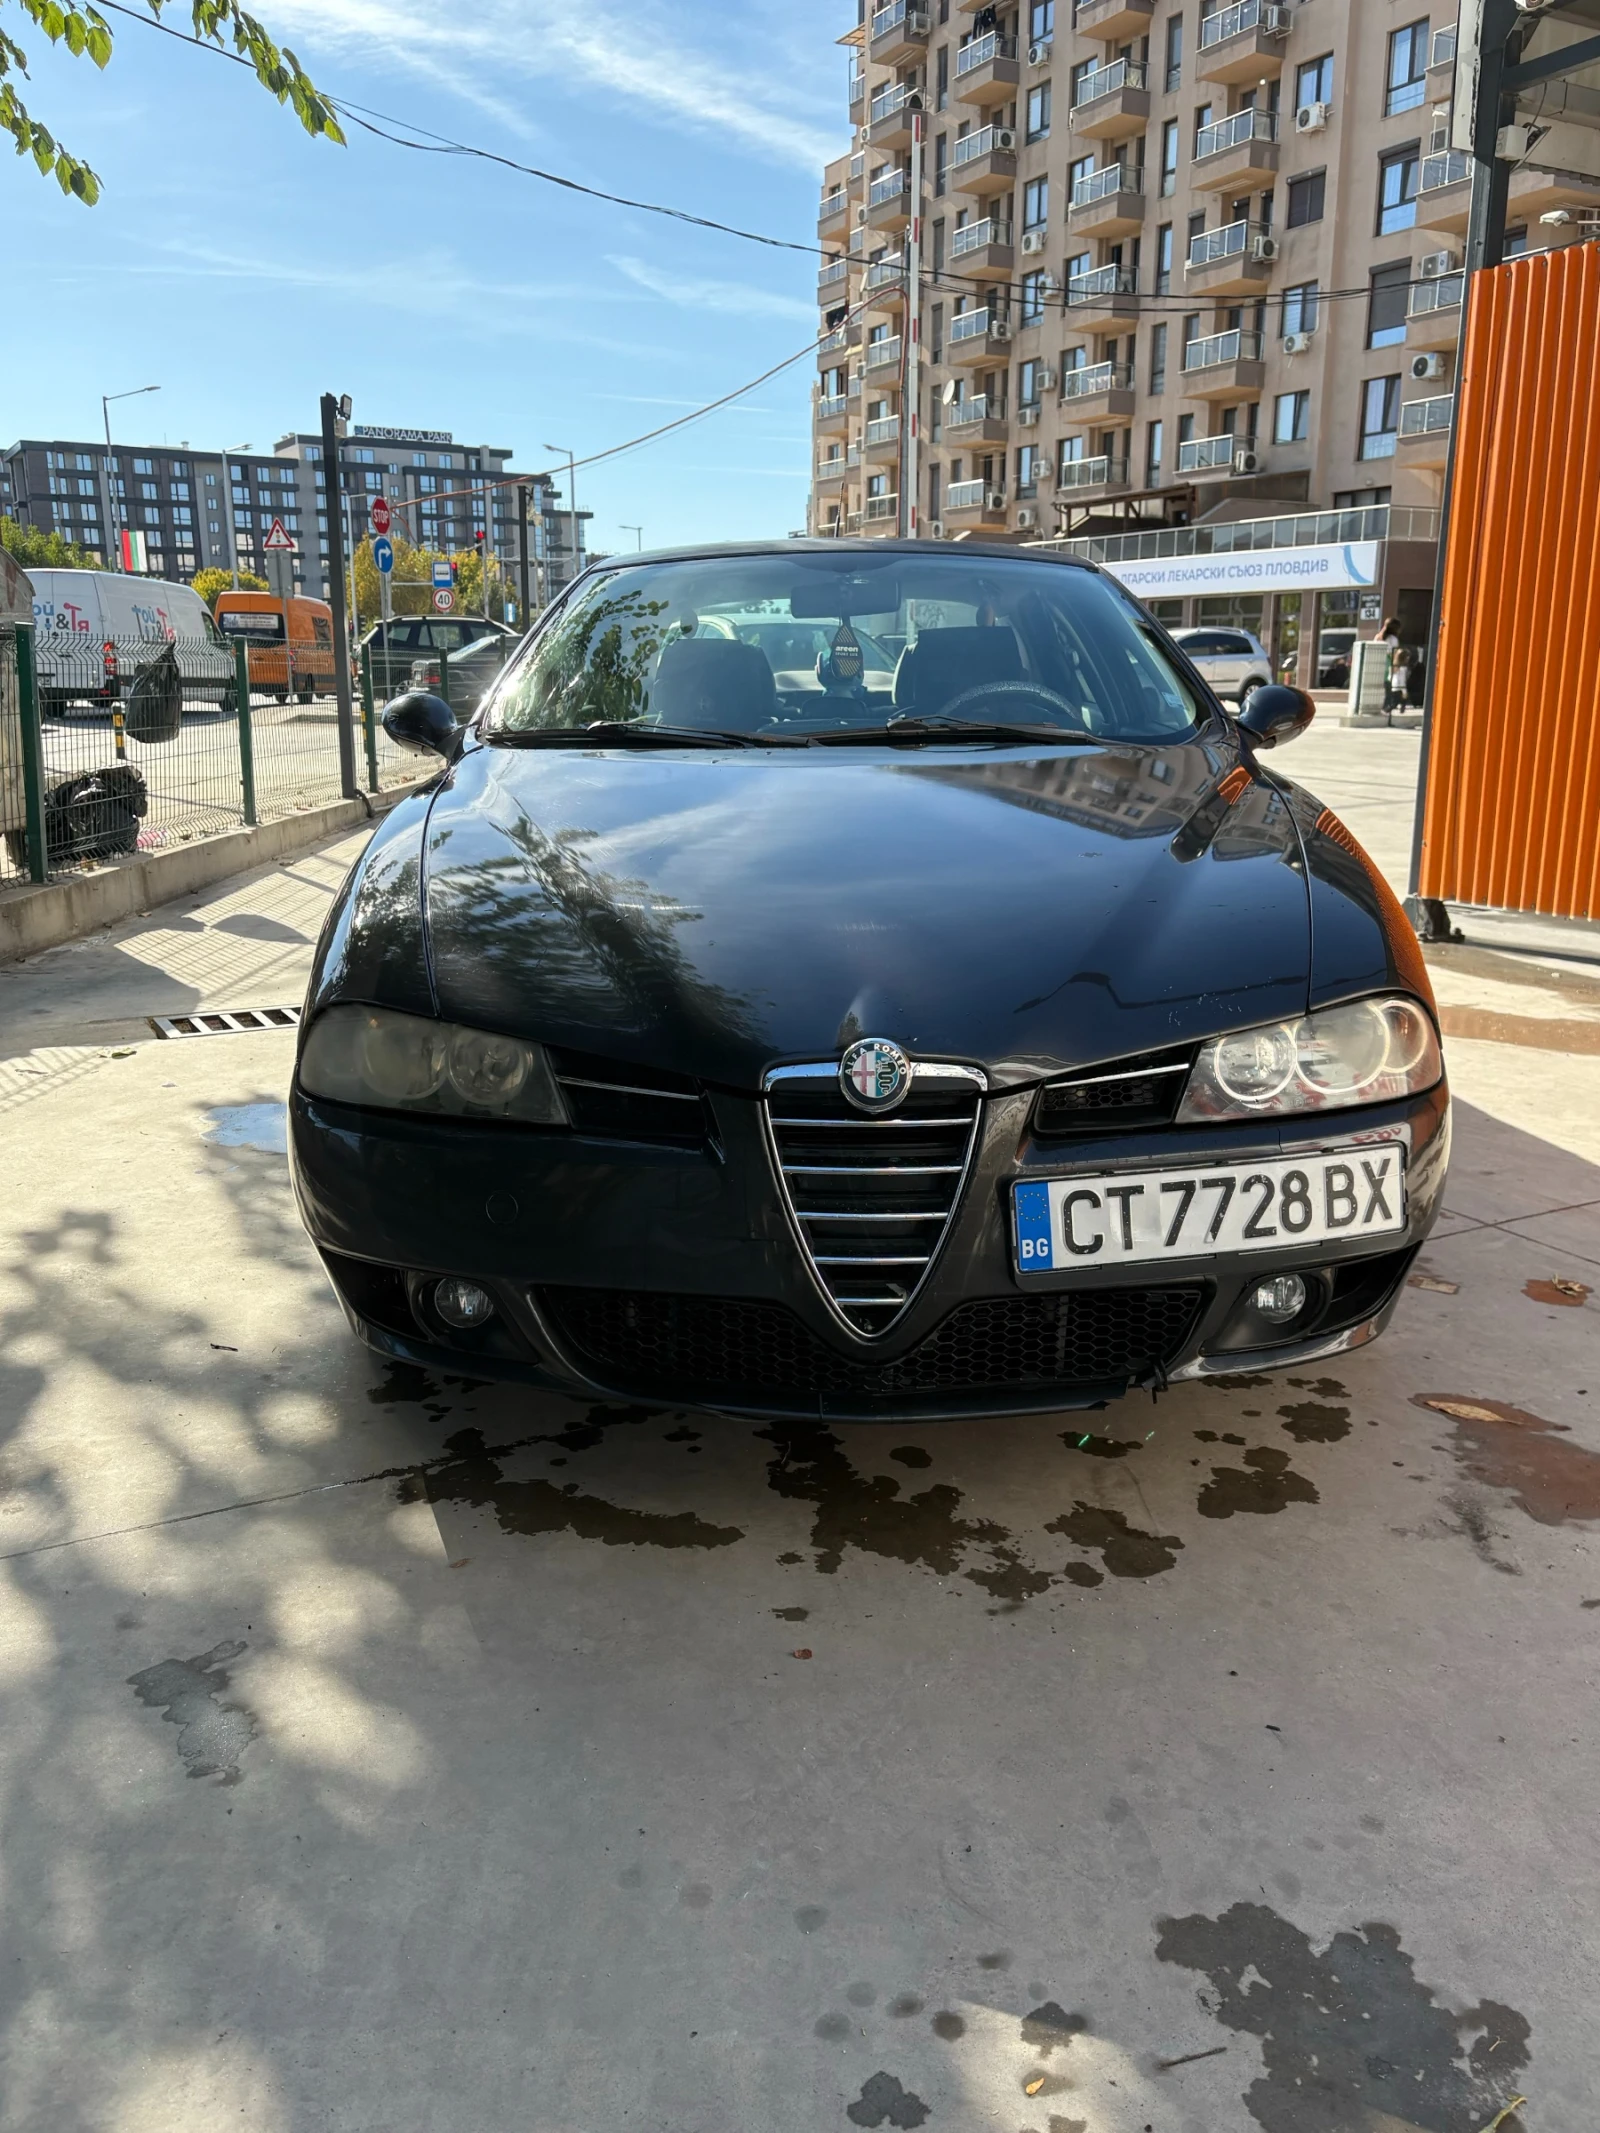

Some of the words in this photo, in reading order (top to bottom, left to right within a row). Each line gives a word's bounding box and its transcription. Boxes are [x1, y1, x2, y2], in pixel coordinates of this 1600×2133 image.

[362, 426, 425, 441] PANORAMA
[427, 432, 453, 443] PARK
[373, 509, 389, 524] STOP
[1119, 571, 1166, 585] ЛГАРСКИ
[1167, 567, 1225, 583] ЛЕКАРСКИ
[1227, 563, 1263, 579] СЪЮЗ
[1265, 558, 1329, 576] ПЛОВДИВ
[438, 594, 450, 605] 40
[845, 1047, 867, 1076] ALFA
[874, 1043, 907, 1075] ROMEO
[1062, 1184, 1145, 1255] CT
[1160, 1169, 1312, 1248] 7728
[1325, 1158, 1392, 1229] BX
[1021, 1238, 1049, 1259] BG
